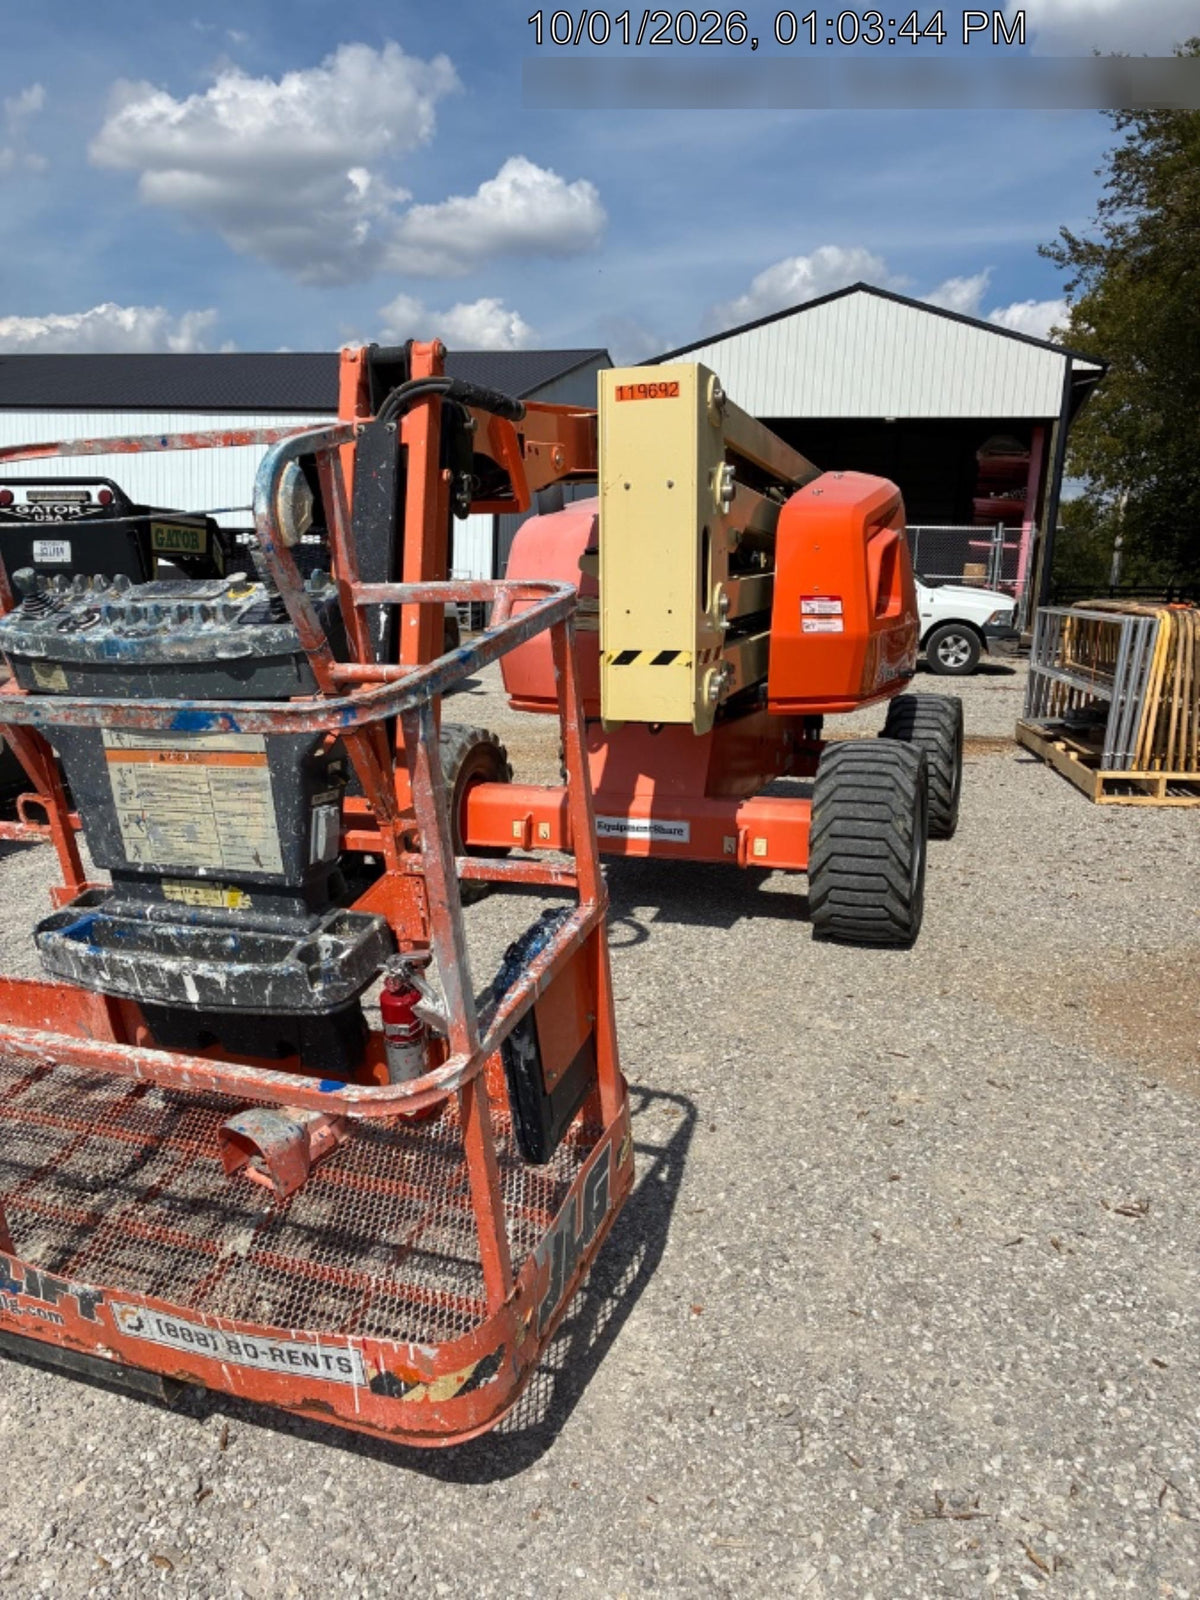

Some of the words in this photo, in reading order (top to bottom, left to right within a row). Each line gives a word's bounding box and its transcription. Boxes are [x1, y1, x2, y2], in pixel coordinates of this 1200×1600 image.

[617, 382, 679, 400] 119692
[16, 505, 81, 515] GATOR
[34, 514, 64, 522] USA
[155, 527, 199, 550] GATOR
[155, 1318, 218, 1350] (888)
[227, 1339, 353, 1373] 80-RENTS
